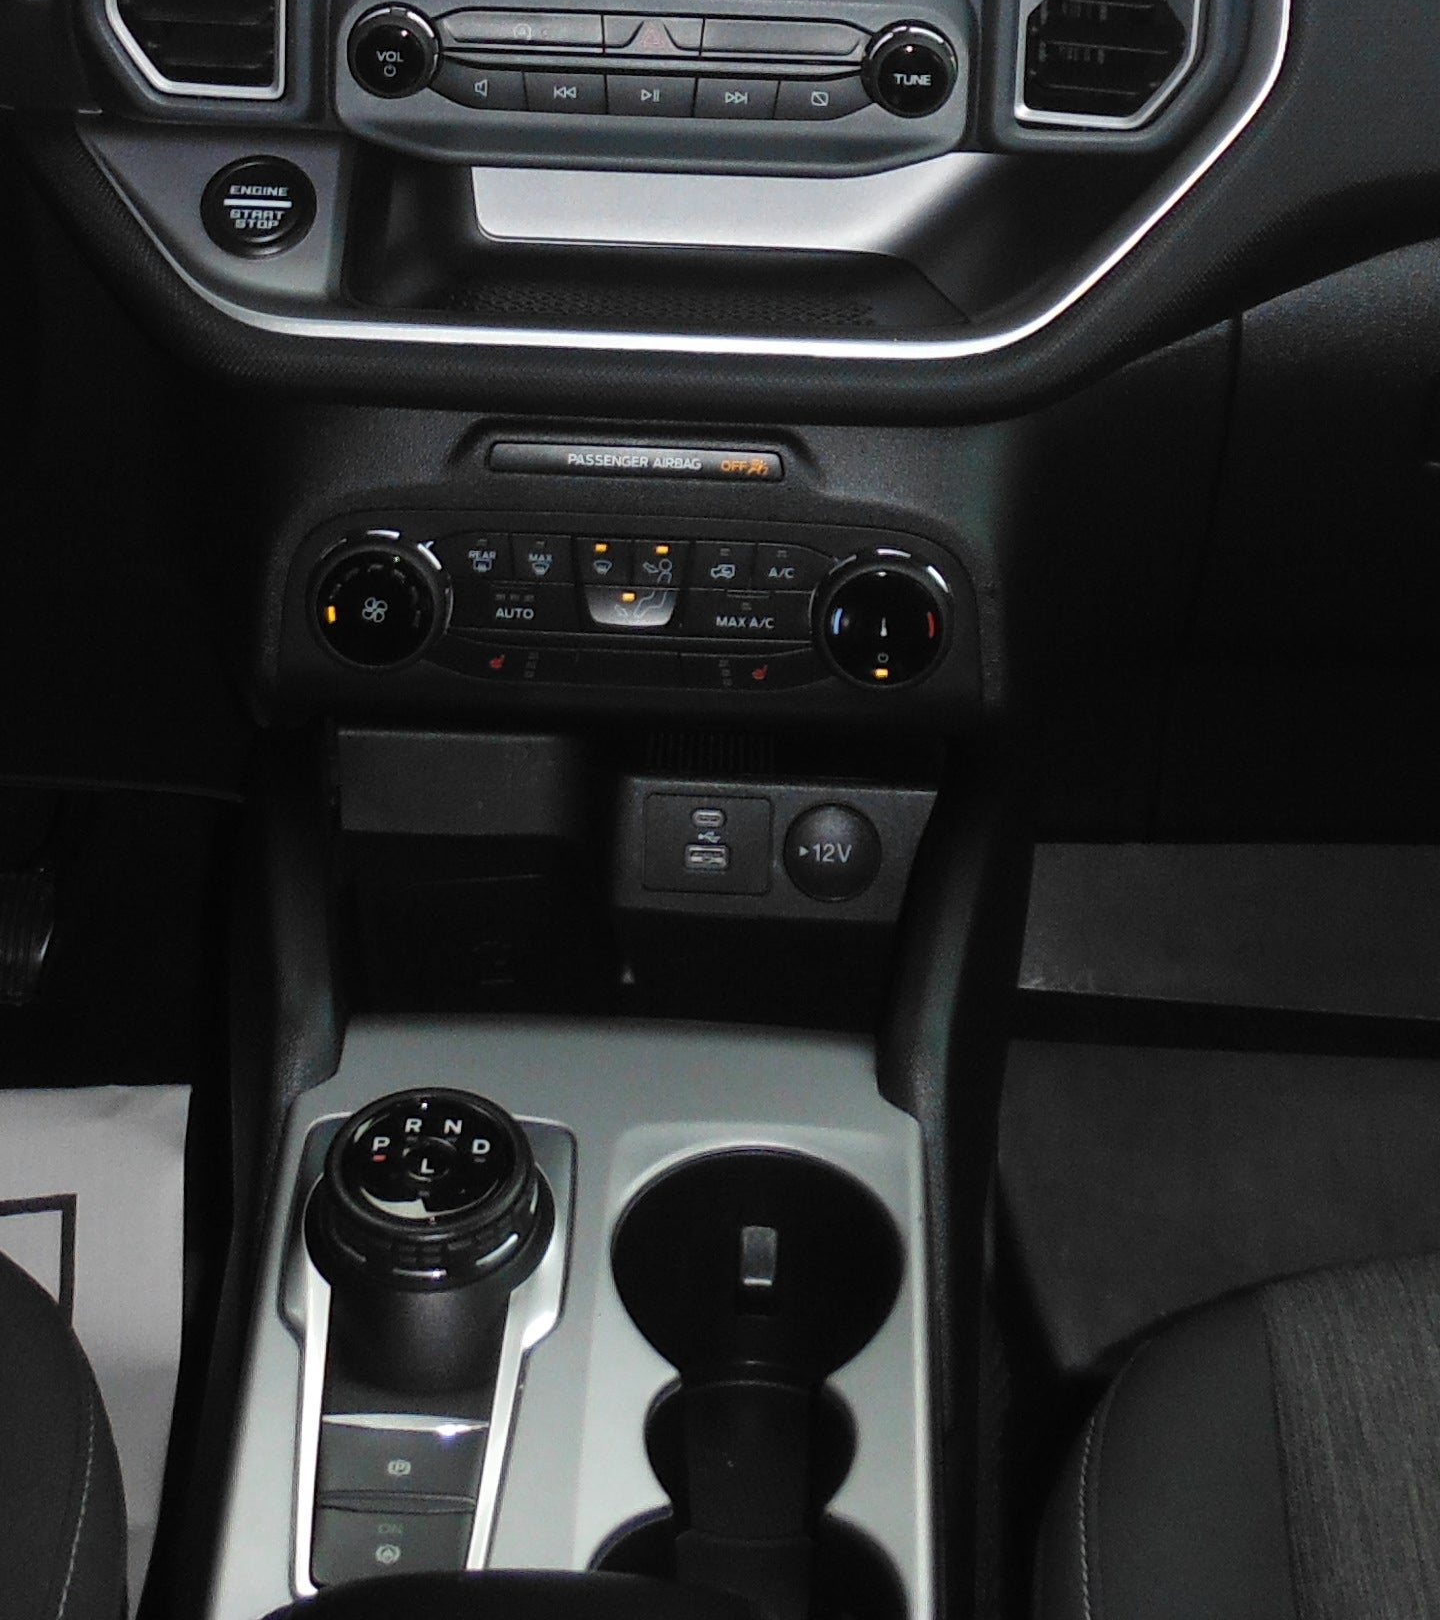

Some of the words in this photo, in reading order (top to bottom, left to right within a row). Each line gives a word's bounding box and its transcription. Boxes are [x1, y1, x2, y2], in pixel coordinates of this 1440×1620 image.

[376, 51, 404, 63] VOL
[894, 72, 931, 88] TUNE
[229, 184, 289, 197] ENGINE
[229, 208, 285, 220] START
[234, 219, 279, 230] STOP
[567, 453, 649, 468] PASSENGER
[652, 456, 702, 471] AIRBAG
[720, 459, 747, 472] OFF
[468, 549, 497, 560] REAR
[527, 553, 553, 563] MAX
[768, 566, 795, 580] A/C
[495, 607, 535, 621] AUTO
[715, 615, 745, 628] MAX
[748, 616, 775, 630] A/C
[812, 843, 852, 864] 12V
[404, 1117, 423, 1133] R
[443, 1118, 463, 1135] N
[372, 1135, 391, 1152] P
[471, 1138, 491, 1155] D
[420, 1157, 435, 1174] L
